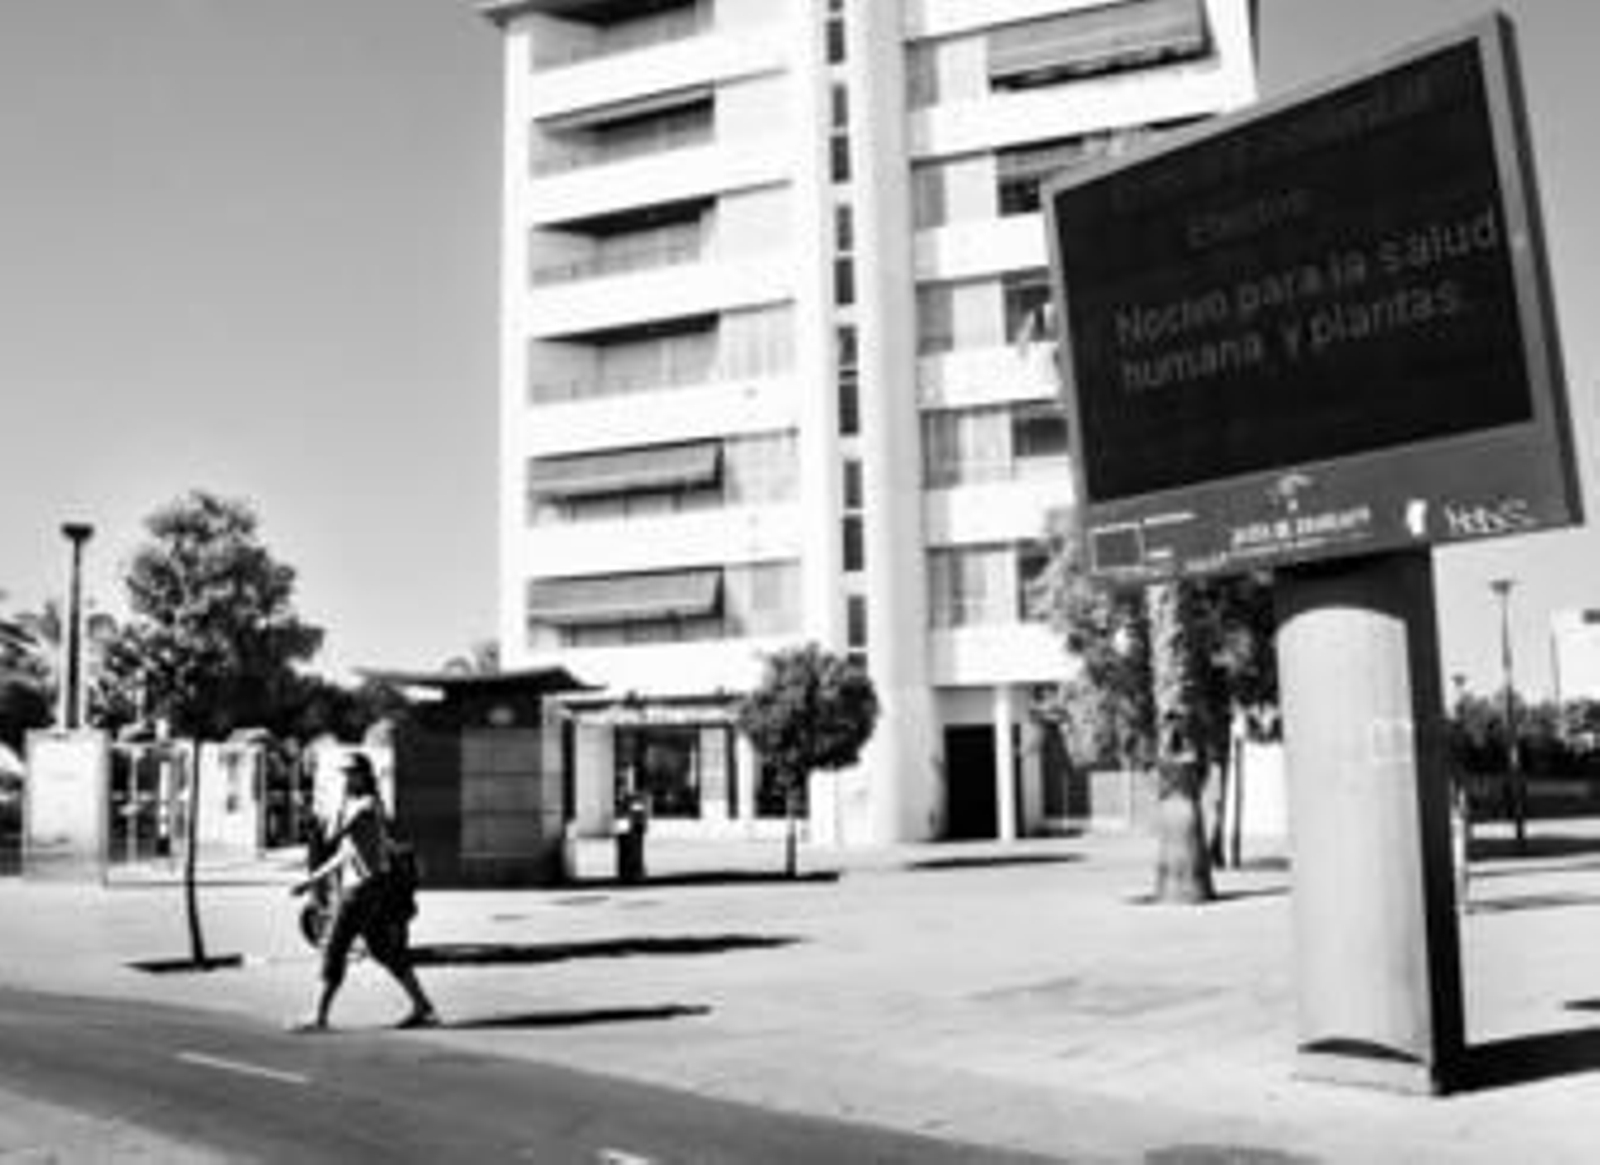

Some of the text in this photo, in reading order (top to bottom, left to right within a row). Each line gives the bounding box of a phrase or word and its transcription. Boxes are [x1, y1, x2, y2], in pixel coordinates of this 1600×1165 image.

[1235, 264, 1322, 322] para
[1328, 248, 1366, 289] la
[1378, 203, 1498, 273] salud
[1121, 332, 1263, 391] humana
[1308, 280, 1460, 354] plantas
